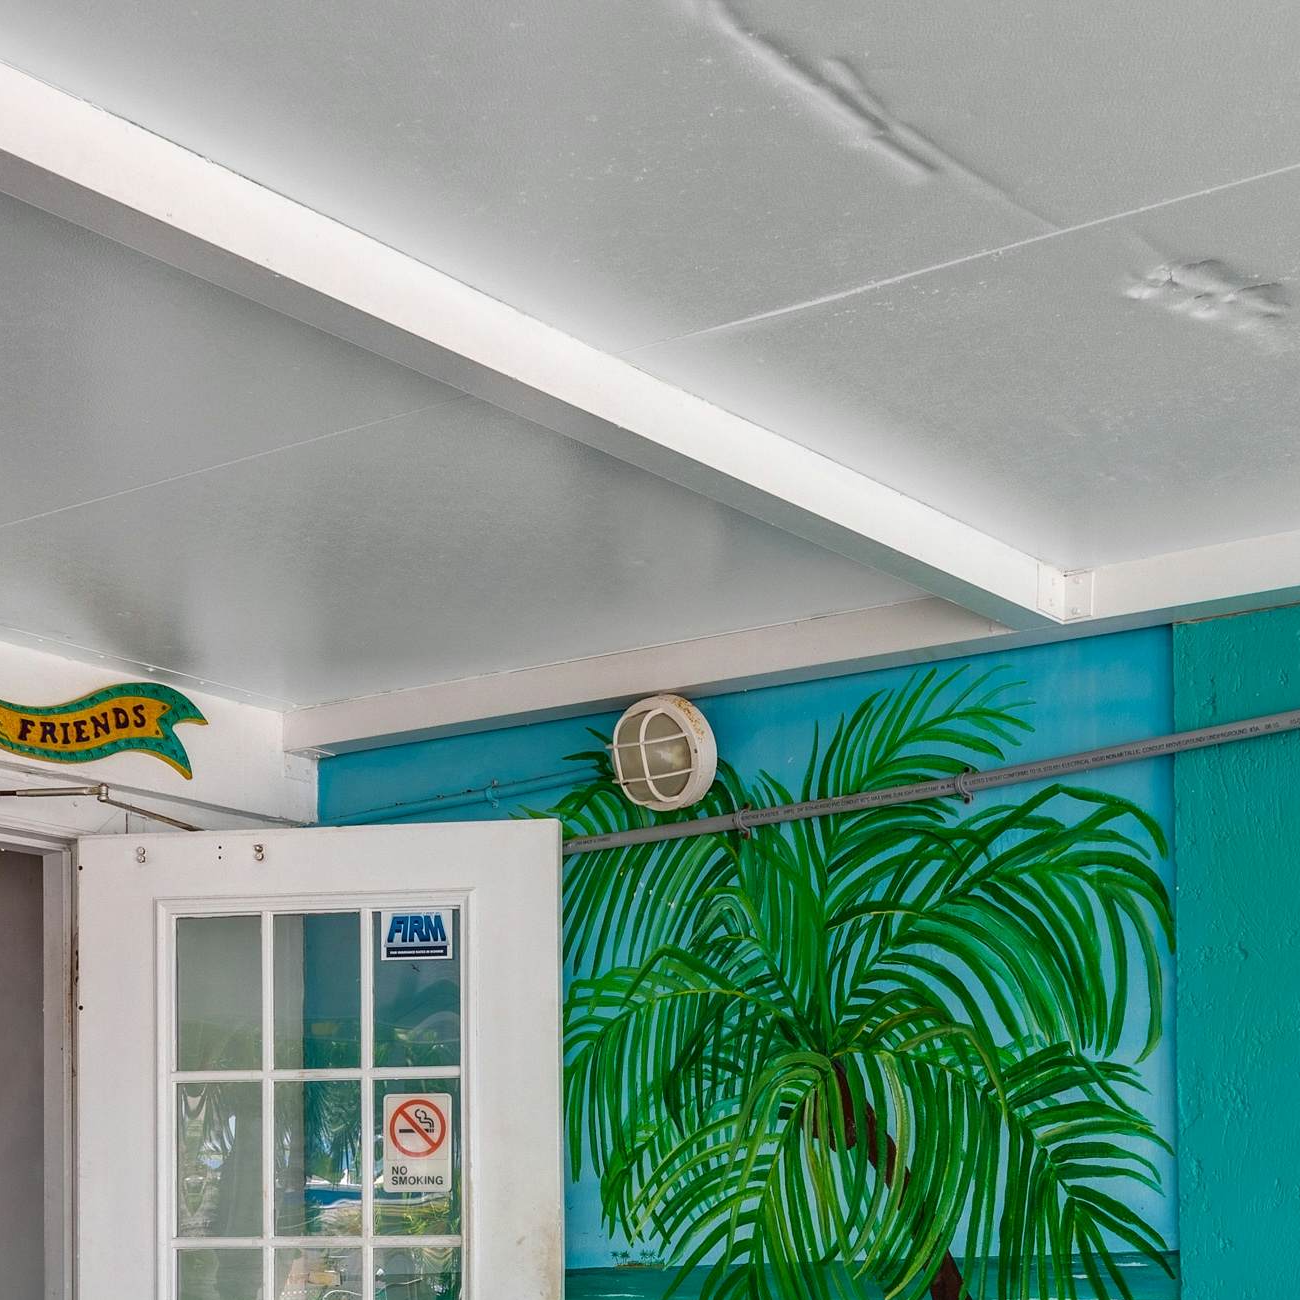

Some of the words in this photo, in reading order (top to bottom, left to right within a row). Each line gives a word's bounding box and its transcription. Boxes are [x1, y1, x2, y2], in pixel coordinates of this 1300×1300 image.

[18, 704, 147, 745] FRIENDS
[387, 915, 446, 943] FIRM
[391, 1166, 408, 1176] NO
[391, 1175, 443, 1185] SMOKING
